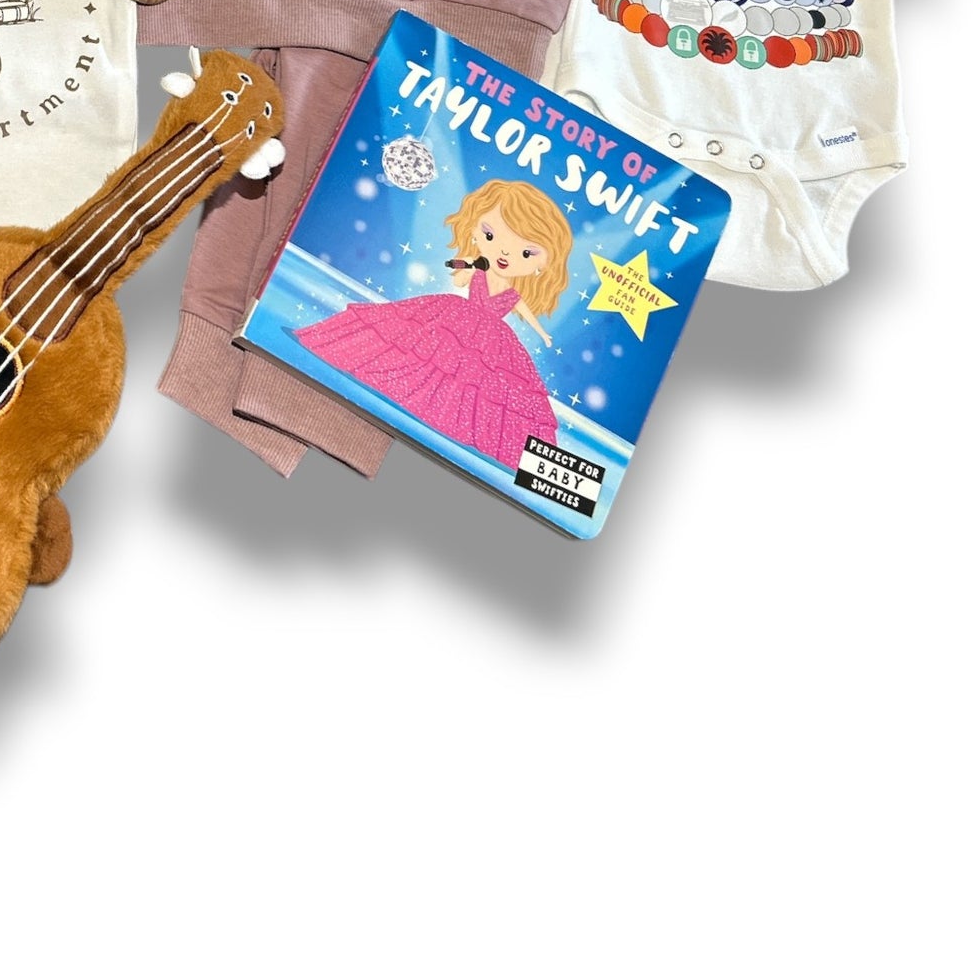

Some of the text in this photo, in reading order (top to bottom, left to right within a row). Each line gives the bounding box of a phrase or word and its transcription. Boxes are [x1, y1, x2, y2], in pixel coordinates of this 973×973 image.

[465, 60, 659, 185] THE STORY OF
[397, 60, 700, 255] TAYLOR SWIFT
[601, 264, 662, 308] UNOFFICIAL
[626, 265, 645, 282] THE
[607, 294, 637, 316] GUIDE
[615, 287, 636, 306] FAN
[529, 438, 600, 479] PERFECT FOR
[537, 461, 584, 490] BABY
[531, 478, 580, 507] SWIFTIES
